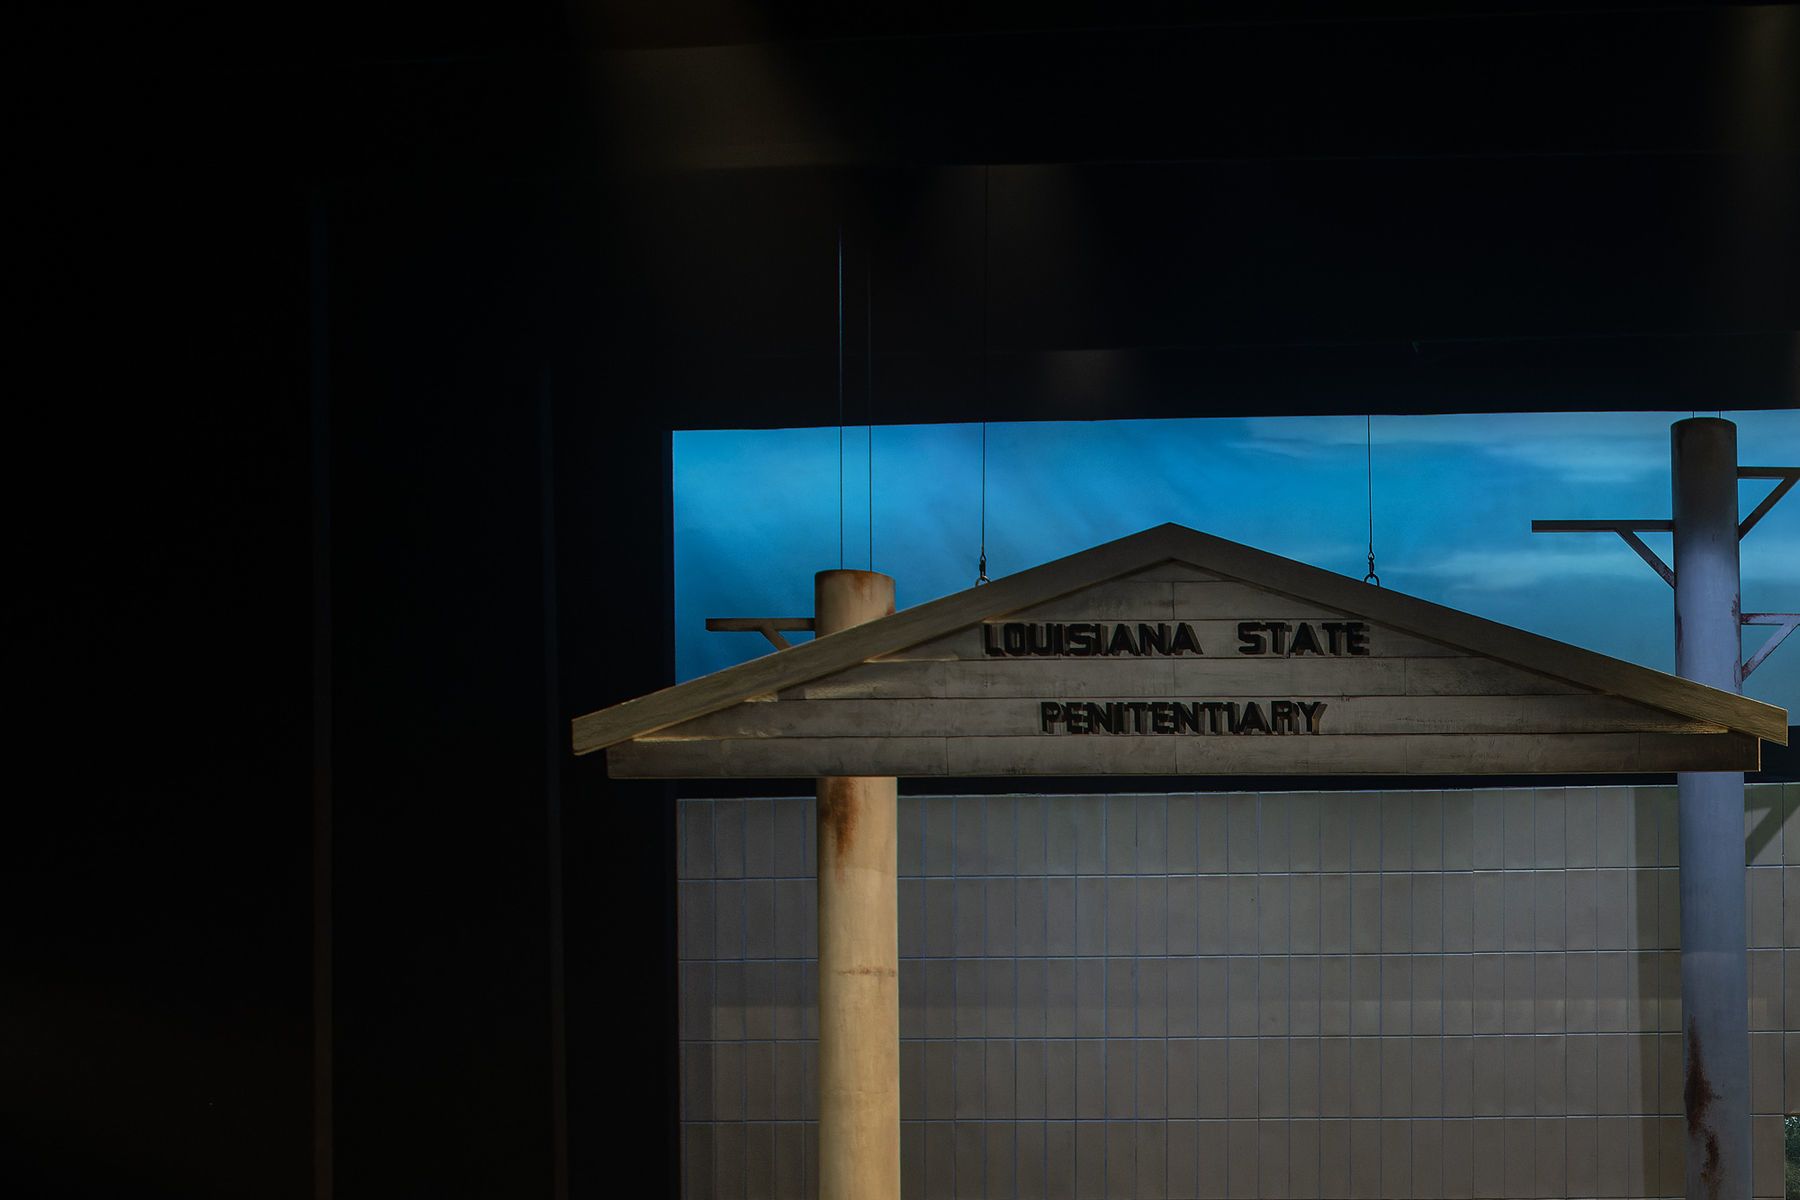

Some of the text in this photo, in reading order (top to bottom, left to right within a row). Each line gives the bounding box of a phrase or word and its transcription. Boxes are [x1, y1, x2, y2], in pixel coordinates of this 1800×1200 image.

[983, 621, 1370, 656] LOUISIANA STATE
[1041, 700, 1328, 735] PENITENTIARY
